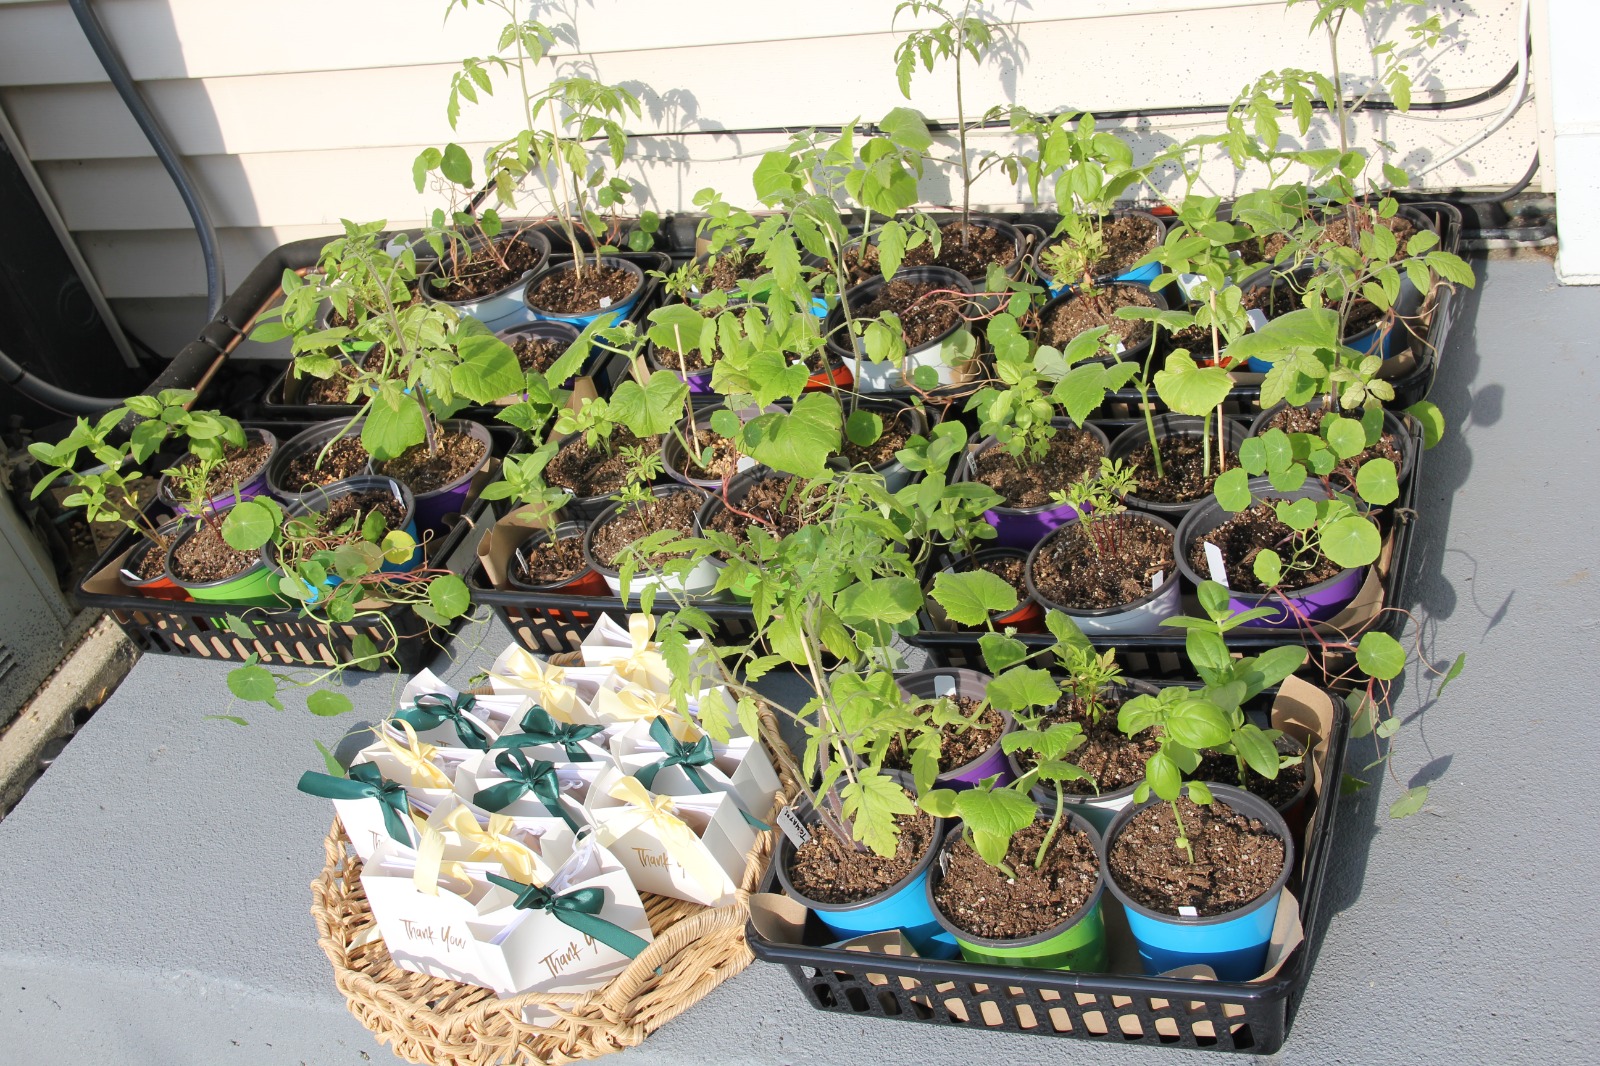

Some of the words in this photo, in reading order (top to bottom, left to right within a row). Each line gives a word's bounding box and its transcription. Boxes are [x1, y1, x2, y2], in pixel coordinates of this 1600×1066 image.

[631, 847, 672, 872] Thank
[399, 918, 437, 944] Thank
[441, 925, 467, 953] You
[538, 941, 583, 979] Thank
